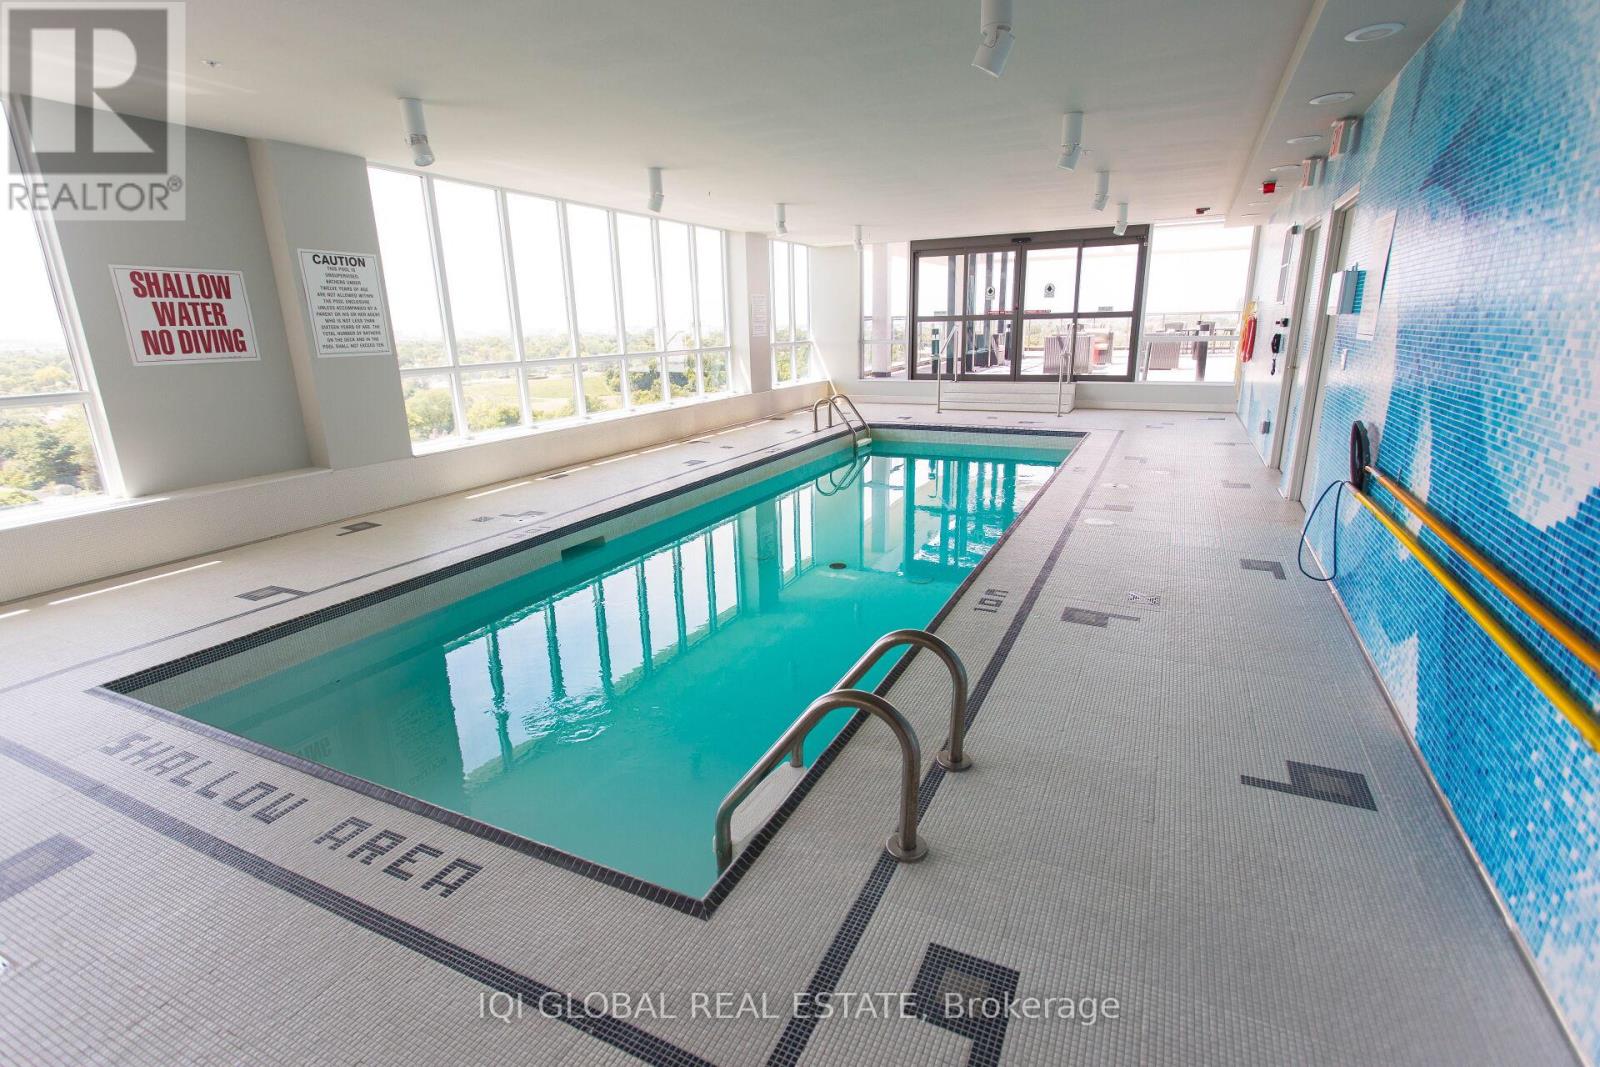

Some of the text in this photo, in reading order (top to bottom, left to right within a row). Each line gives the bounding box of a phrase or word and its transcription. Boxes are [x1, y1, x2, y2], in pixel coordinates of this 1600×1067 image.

[312, 254, 366, 267] CAUTION
[129, 270, 232, 300] SHALLOW
[152, 301, 228, 327] WATER
[141, 328, 247, 356] NO DIVING
[103, 730, 483, 899] SHALLOW AREA
